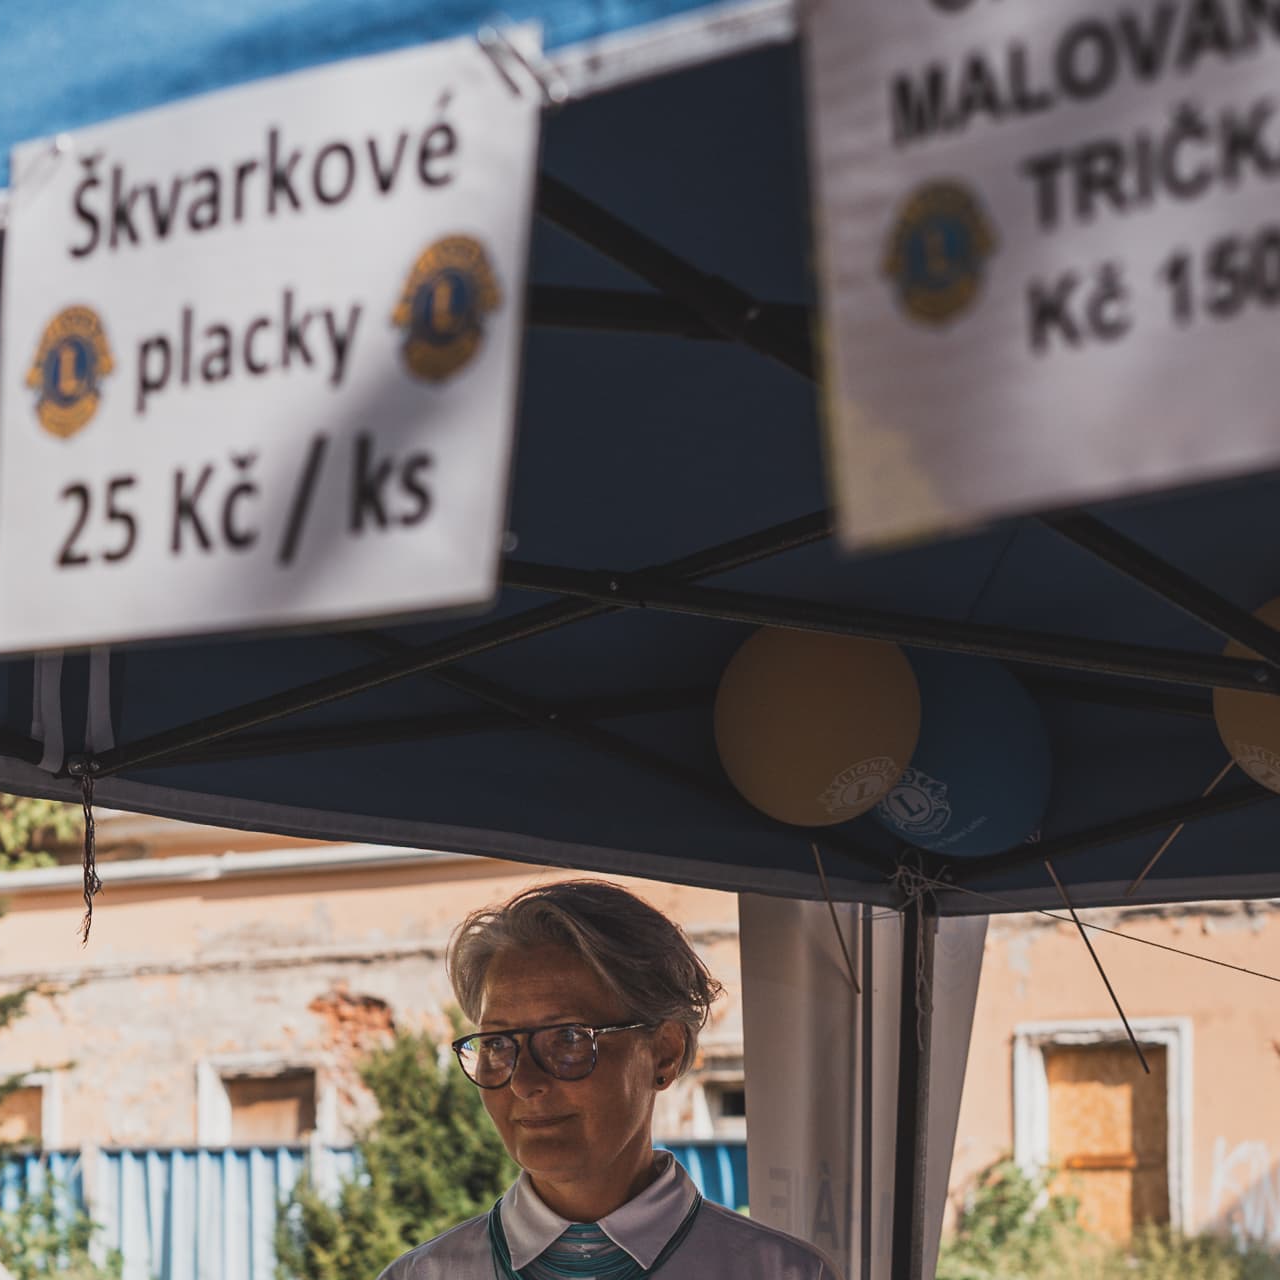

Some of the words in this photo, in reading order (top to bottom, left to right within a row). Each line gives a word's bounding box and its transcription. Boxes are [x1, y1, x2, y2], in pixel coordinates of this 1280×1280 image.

[68, 91, 459, 260] Škvarkové
[134, 289, 363, 417] placky
[1025, 262, 1133, 353] Kč
[55, 472, 139, 569] 25
[169, 450, 260, 556] Kč
[347, 429, 436, 539] ks
[892, 793, 926, 817] L
